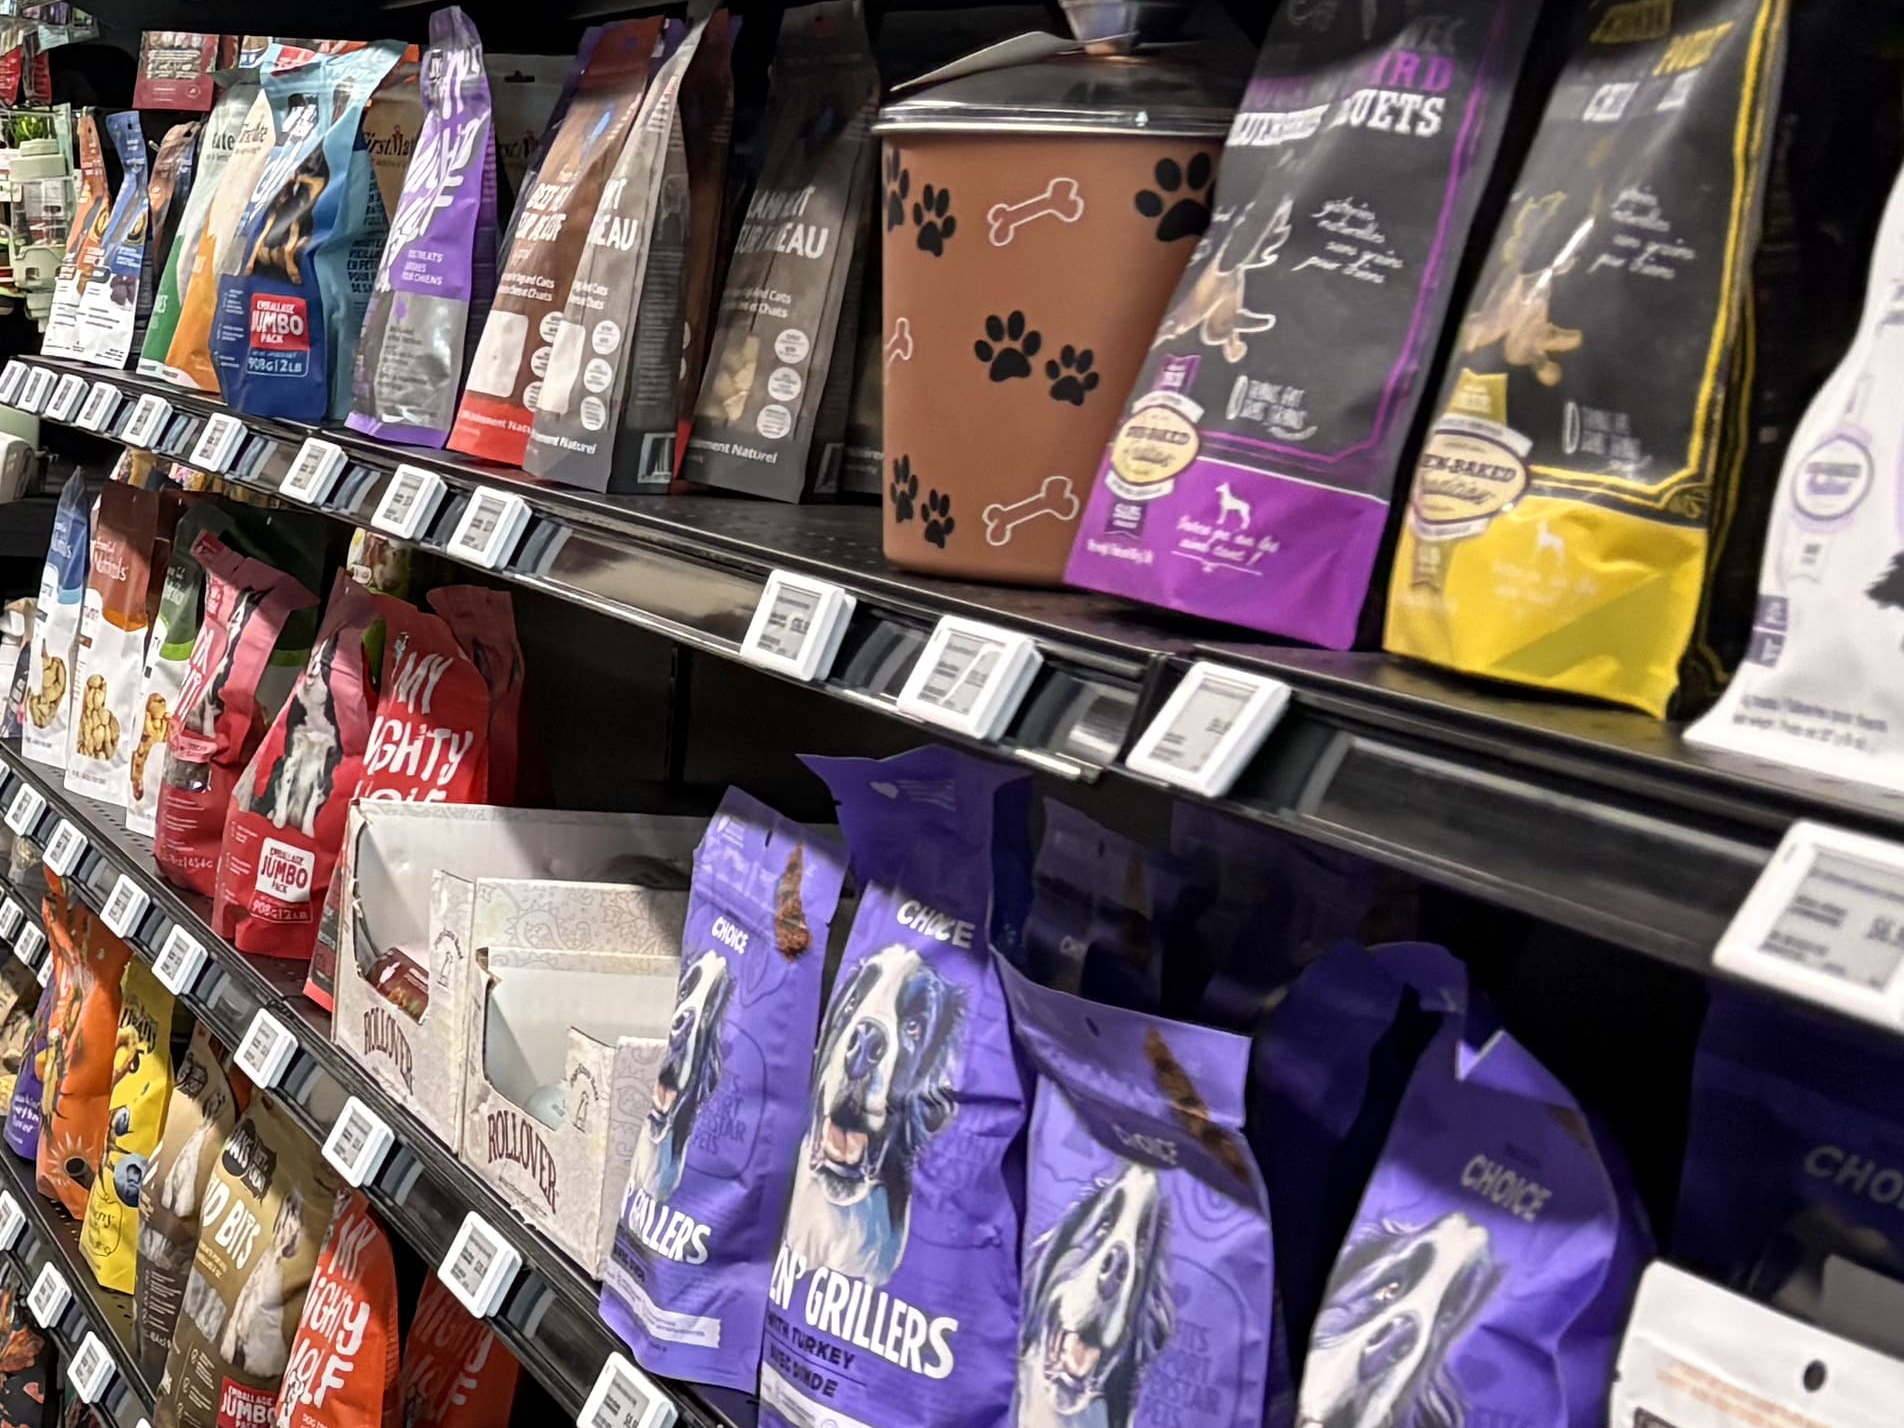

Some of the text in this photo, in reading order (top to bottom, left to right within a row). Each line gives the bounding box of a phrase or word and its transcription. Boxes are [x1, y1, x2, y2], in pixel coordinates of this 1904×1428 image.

[251, 311, 304, 335] JUMBO
[260, 333, 284, 344] PACK
[559, 434, 599, 454] Naturel
[731, 445, 778, 464] Naturel
[1424, 453, 1518, 482] EN-BAKED
[260, 855, 308, 890] JUMBO
[711, 915, 749, 955] CHOICE
[896, 899, 977, 949] CHOICE
[363, 1007, 413, 1096] ROLLOVER
[488, 1110, 557, 1215] ROLLOVER
[1802, 1145, 1904, 1215] CHO
[1459, 1152, 1554, 1223] CHOICE
[214, 1201, 262, 1270] BITS
[804, 1265, 959, 1379] GRILLERS
[790, 1326, 857, 1370] TURKEY
